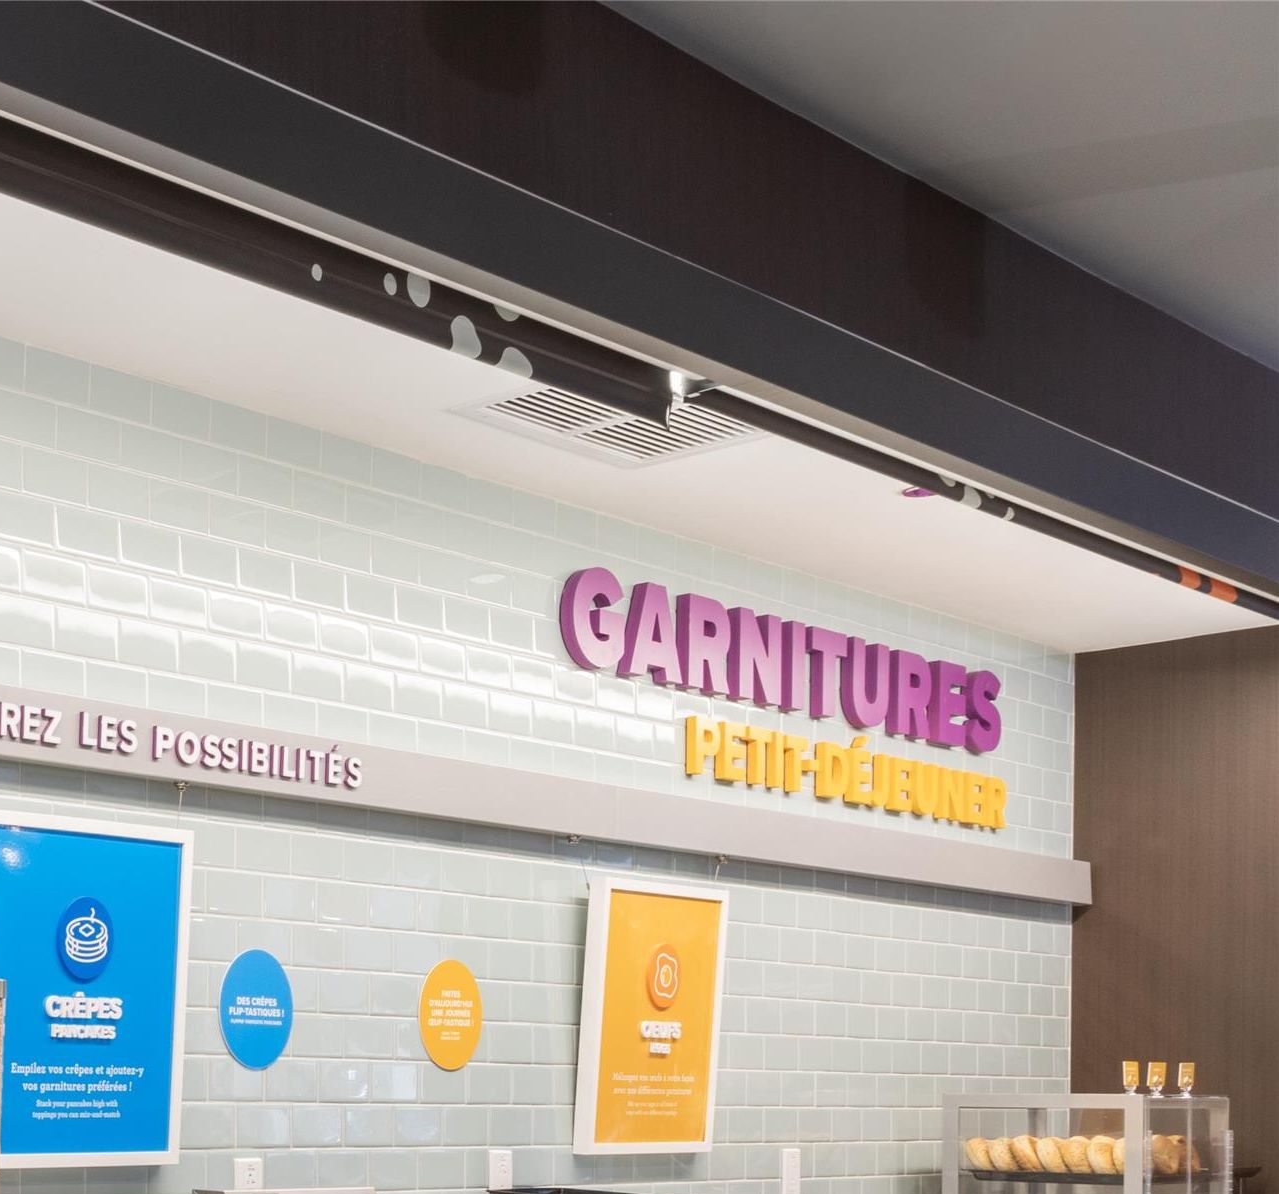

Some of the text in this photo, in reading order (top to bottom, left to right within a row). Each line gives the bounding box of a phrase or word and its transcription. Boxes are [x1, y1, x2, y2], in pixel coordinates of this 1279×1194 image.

[559, 566, 1002, 755] GARNITURES
[79, 711, 139, 754] LES
[152, 724, 363, 789] POSSIBILITÉS
[685, 715, 1008, 830] PETIT-DÉJEUNER
[45, 991, 123, 1020] CRÊPES
[50, 1024, 117, 1039] PANCAKES
[11, 1062, 46, 1076] Empilez
[48, 1065, 63, 1074] vos
[65, 1064, 93, 1076] crêpes
[95, 1066, 104, 1075] et
[22, 1082, 38, 1091] vos
[40, 1081, 85, 1093] garnitures
